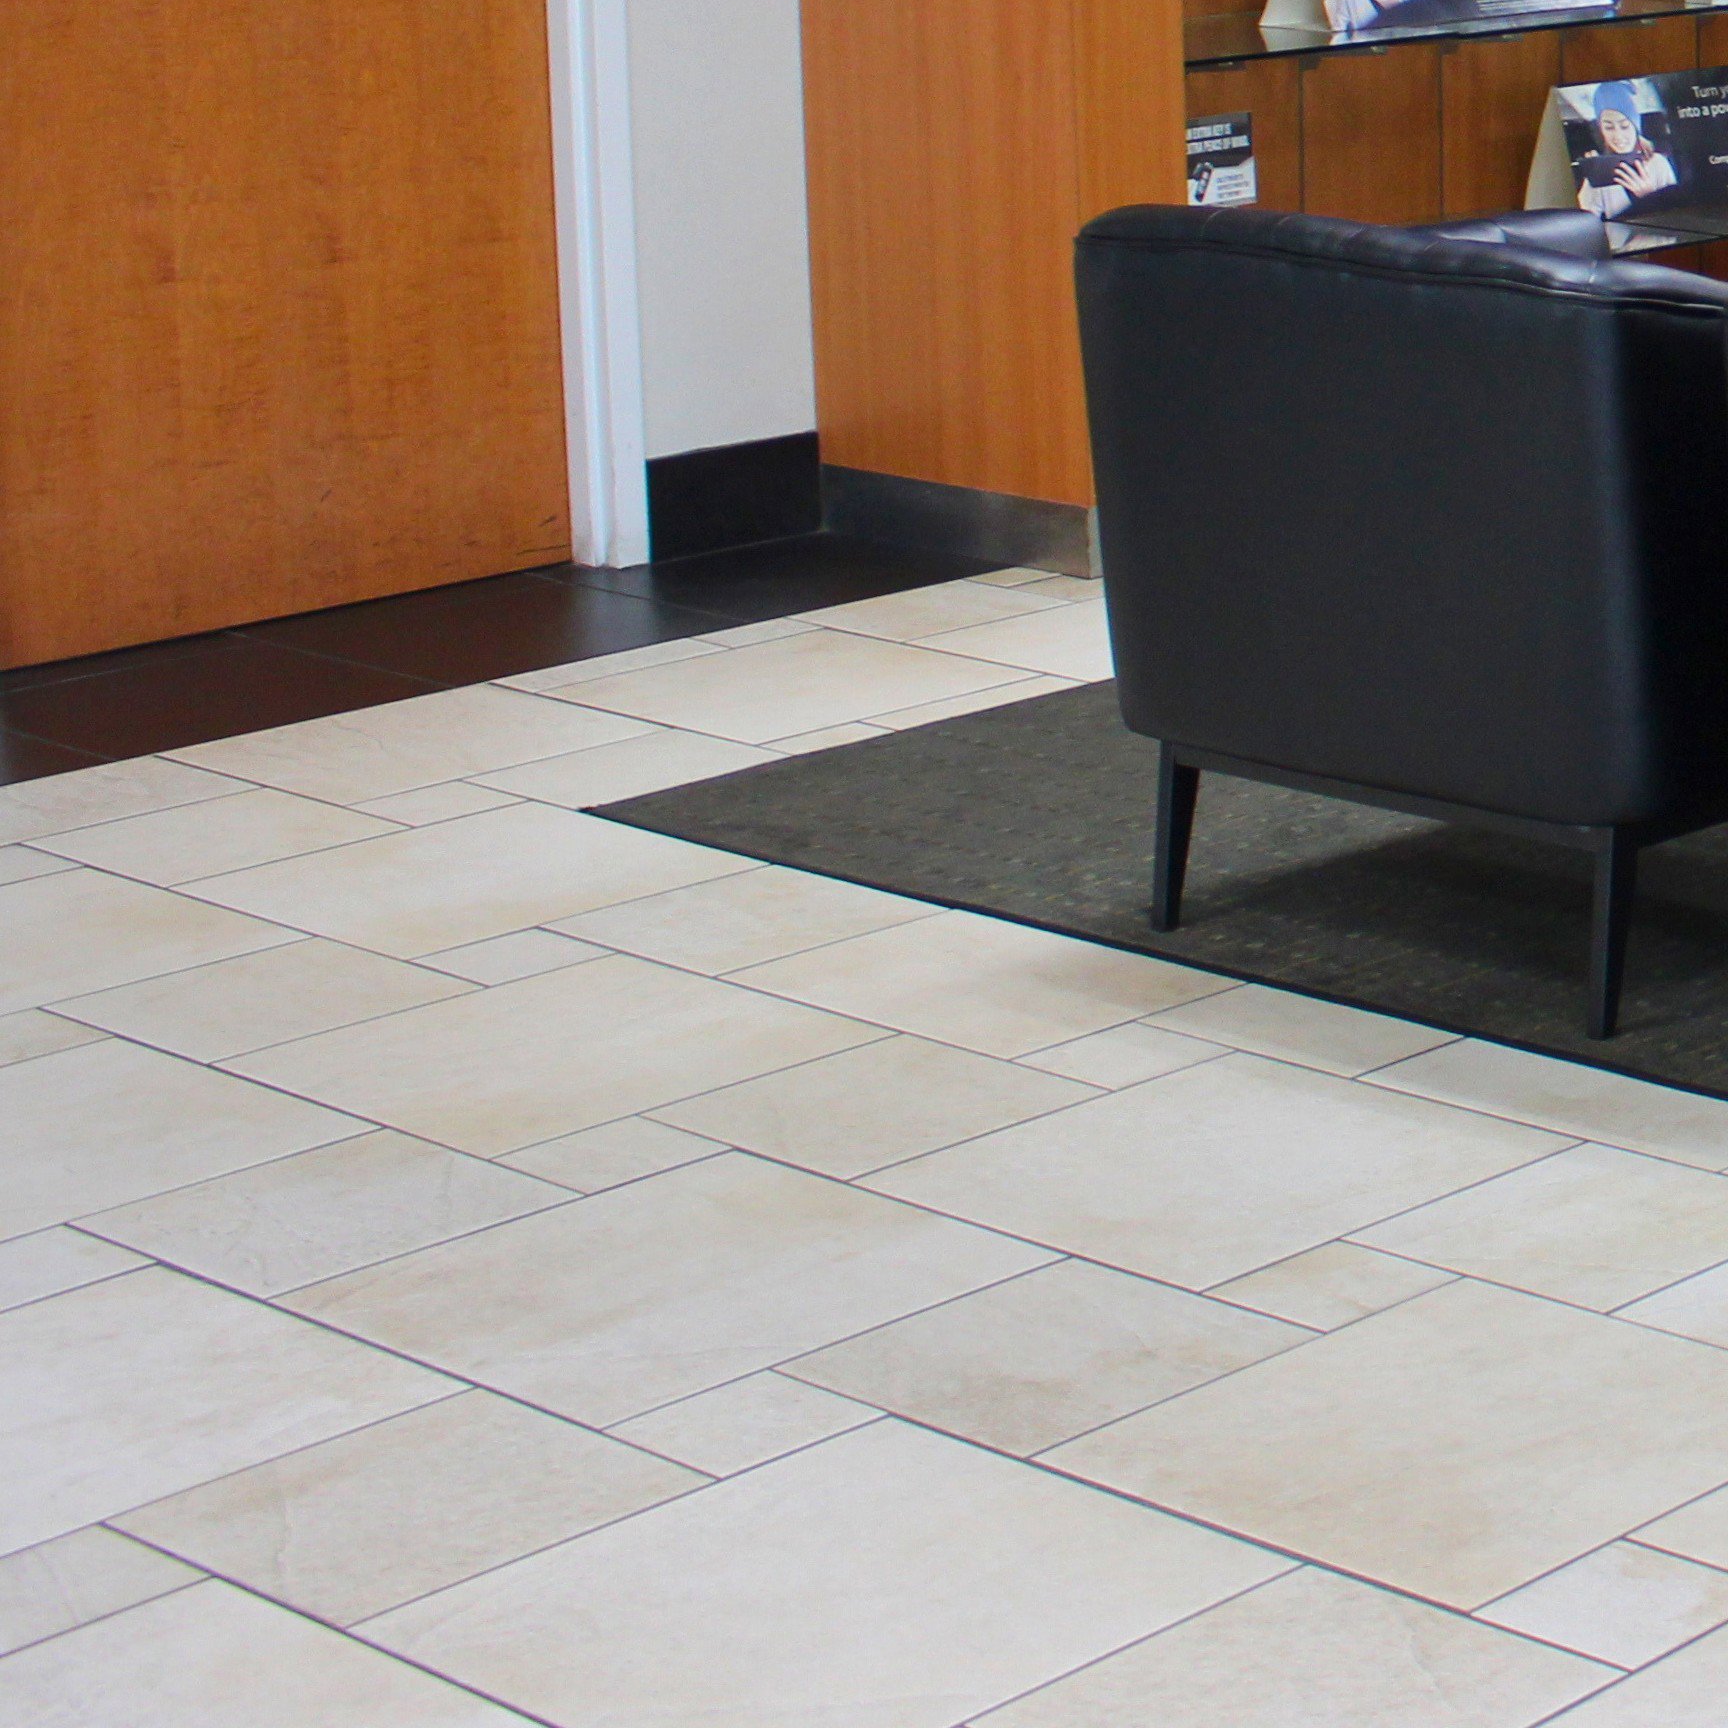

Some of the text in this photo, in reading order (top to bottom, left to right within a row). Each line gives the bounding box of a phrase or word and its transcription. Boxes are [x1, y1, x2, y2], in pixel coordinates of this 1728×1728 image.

[1691, 85, 1719, 99] Turn
[1677, 105, 1701, 119] into
[1701, 105, 1711, 116] a
